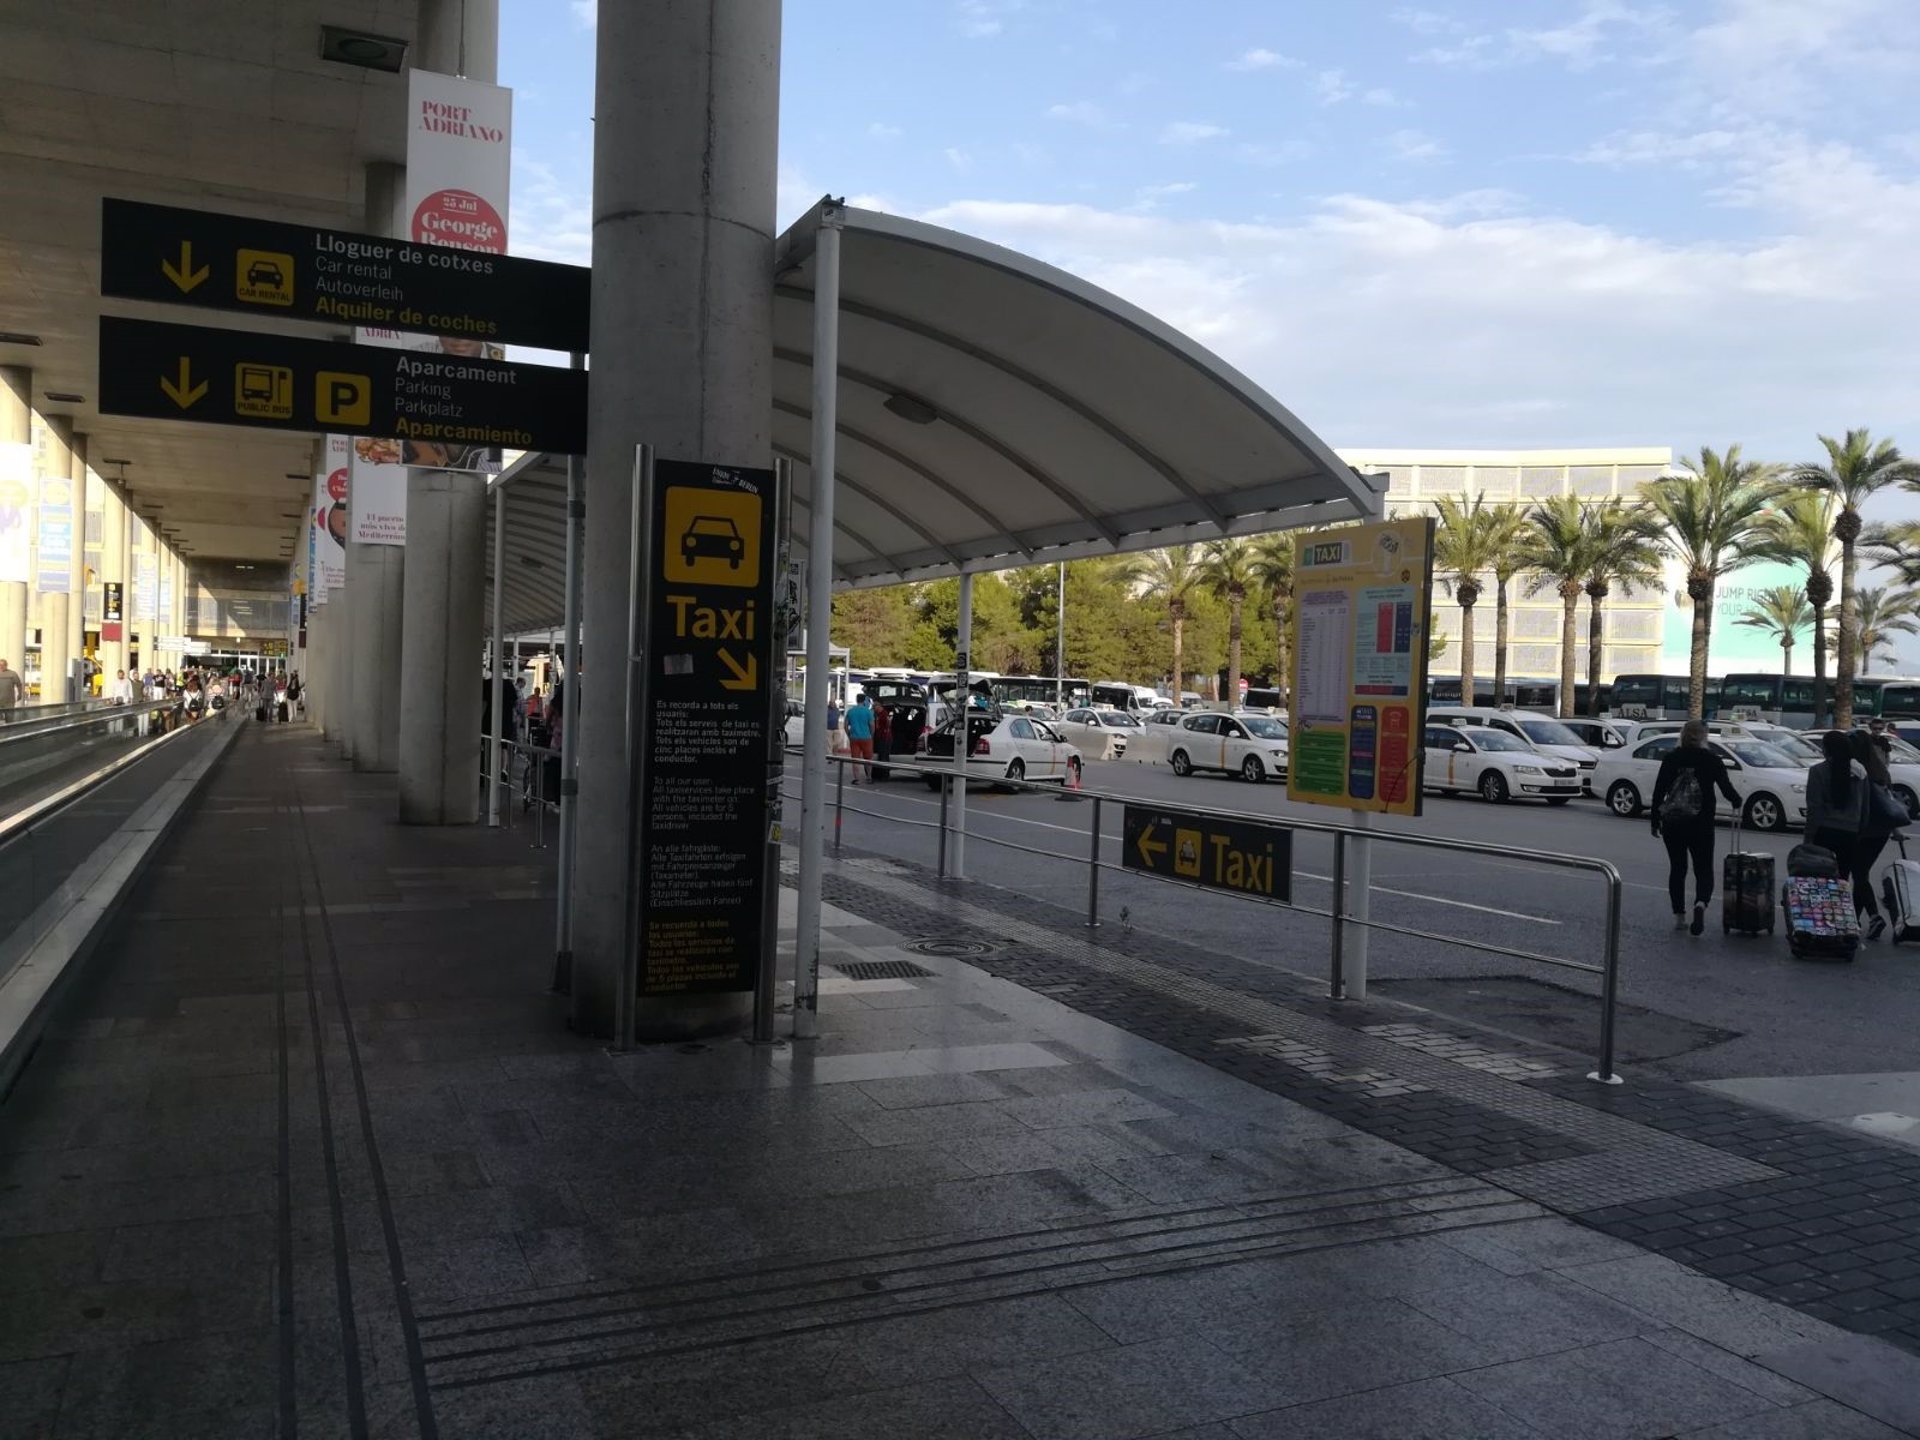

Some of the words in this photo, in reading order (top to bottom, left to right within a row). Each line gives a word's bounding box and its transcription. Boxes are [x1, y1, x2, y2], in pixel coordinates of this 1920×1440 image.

[421, 100, 471, 122] PORT
[420, 115, 504, 143] ADRIANO
[443, 196, 457, 209] 25
[459, 199, 478, 211] Jul
[421, 211, 498, 240] George
[316, 232, 393, 260] Lloguer
[399, 246, 422, 265] de
[428, 253, 493, 275] cotxes
[315, 255, 342, 273] Car
[347, 264, 392, 281] rental
[239, 287, 257, 298] CAR
[259, 289, 289, 302] RENTAL
[315, 275, 404, 302] Autoverleih
[316, 295, 394, 321] Alquiler
[399, 307, 422, 325] de
[428, 315, 497, 335] coches
[396, 356, 517, 385] Aparcament
[331, 382, 359, 416] P
[394, 377, 452, 400] Parking
[237, 402, 270, 412] PUBLIC
[272, 404, 291, 414] BUS
[394, 397, 464, 418] Parkplatz
[396, 417, 533, 445] Aparcamiento
[1316, 546, 1340, 563] TAXI
[1716, 586, 1744, 600] JUMP
[666, 595, 755, 641] Taxi
[669, 701, 700, 710] recorda
[1618, 707, 1648, 719] ALSA
[1210, 833, 1274, 894] Taxi
